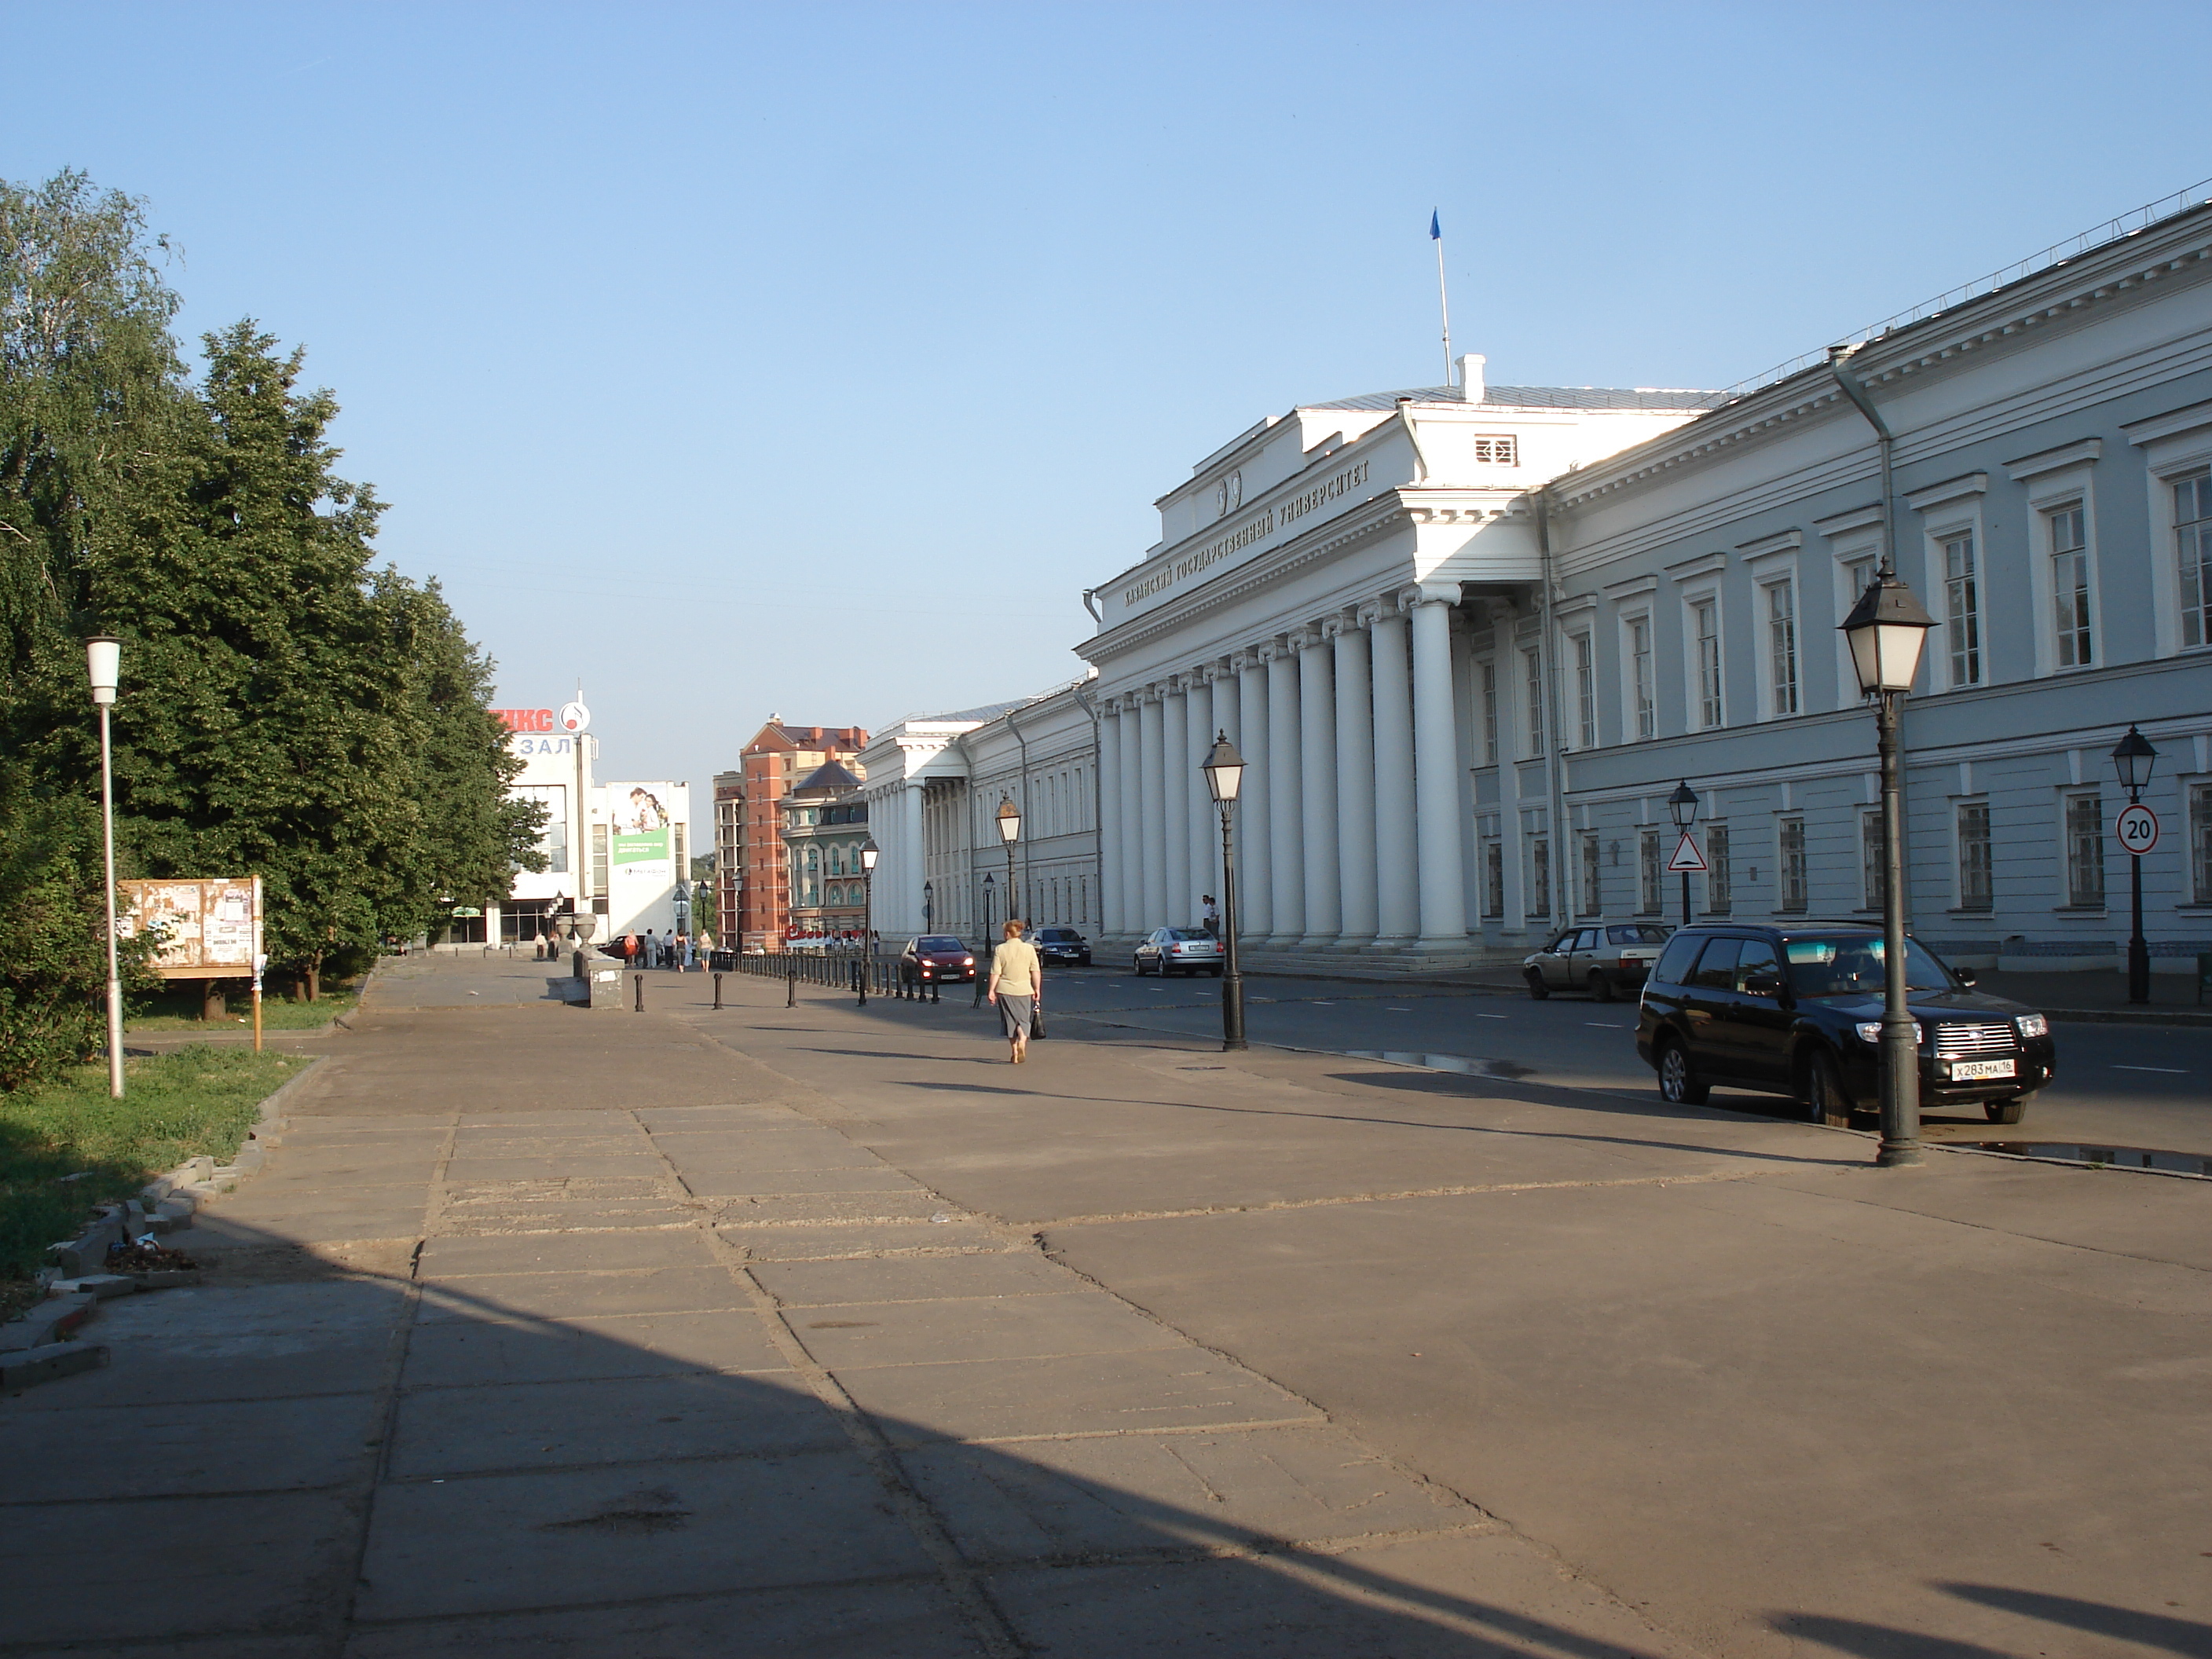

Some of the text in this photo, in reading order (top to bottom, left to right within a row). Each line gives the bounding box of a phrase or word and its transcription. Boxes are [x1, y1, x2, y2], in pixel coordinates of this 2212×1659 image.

[1125, 460, 1368, 607] КАЗАНСКИЙ ГОСУДАРСТВЕННЫЙ УНИВЕРСИТЕТ
[520, 739, 570, 754] ЗАЛ
[2127, 819, 2150, 839] 20
